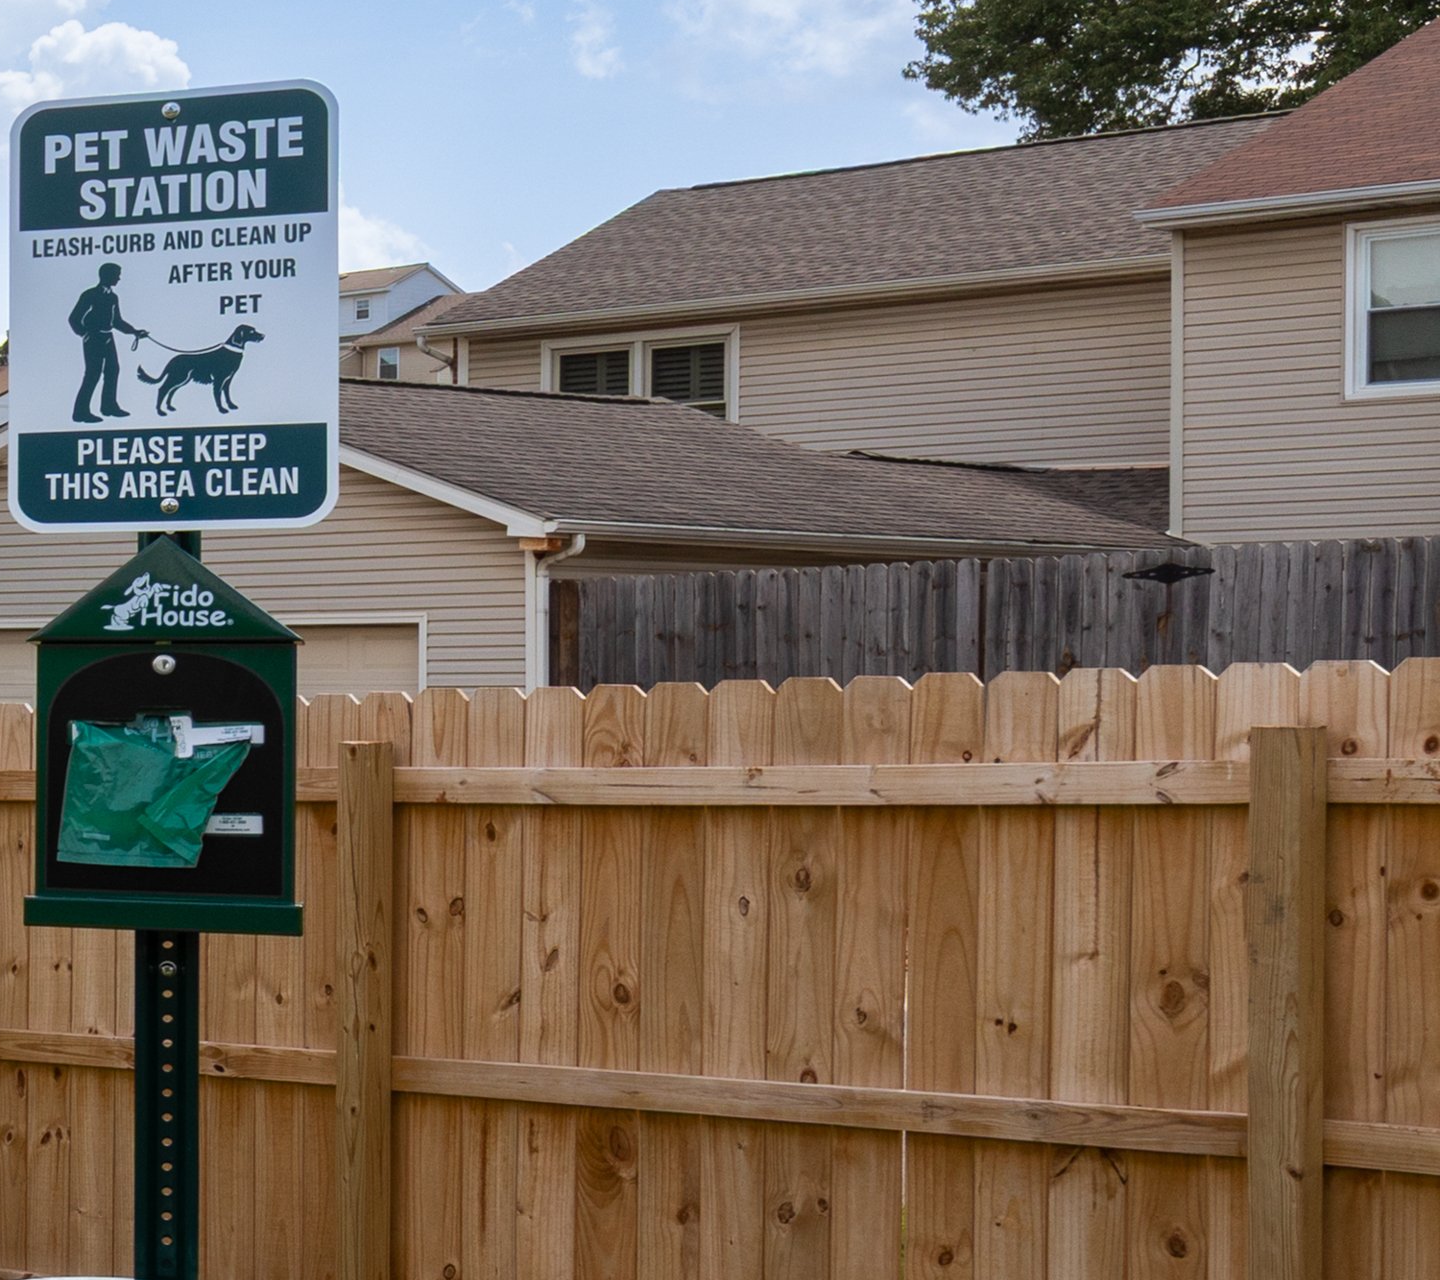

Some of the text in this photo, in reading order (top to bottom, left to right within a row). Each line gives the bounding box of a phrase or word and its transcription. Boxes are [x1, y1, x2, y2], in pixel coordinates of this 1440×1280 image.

[44, 116, 304, 174] PET WASTE
[80, 169, 267, 219] STATION
[32, 222, 312, 258] LEASH-CURB AND CLEAN UP
[168, 258, 296, 284] AFTER YOUR
[219, 294, 262, 315] PET
[77, 433, 267, 466] PLEASE KEEP
[45, 467, 299, 501] THIS AREA CLEAN
[153, 583, 214, 607] Fido
